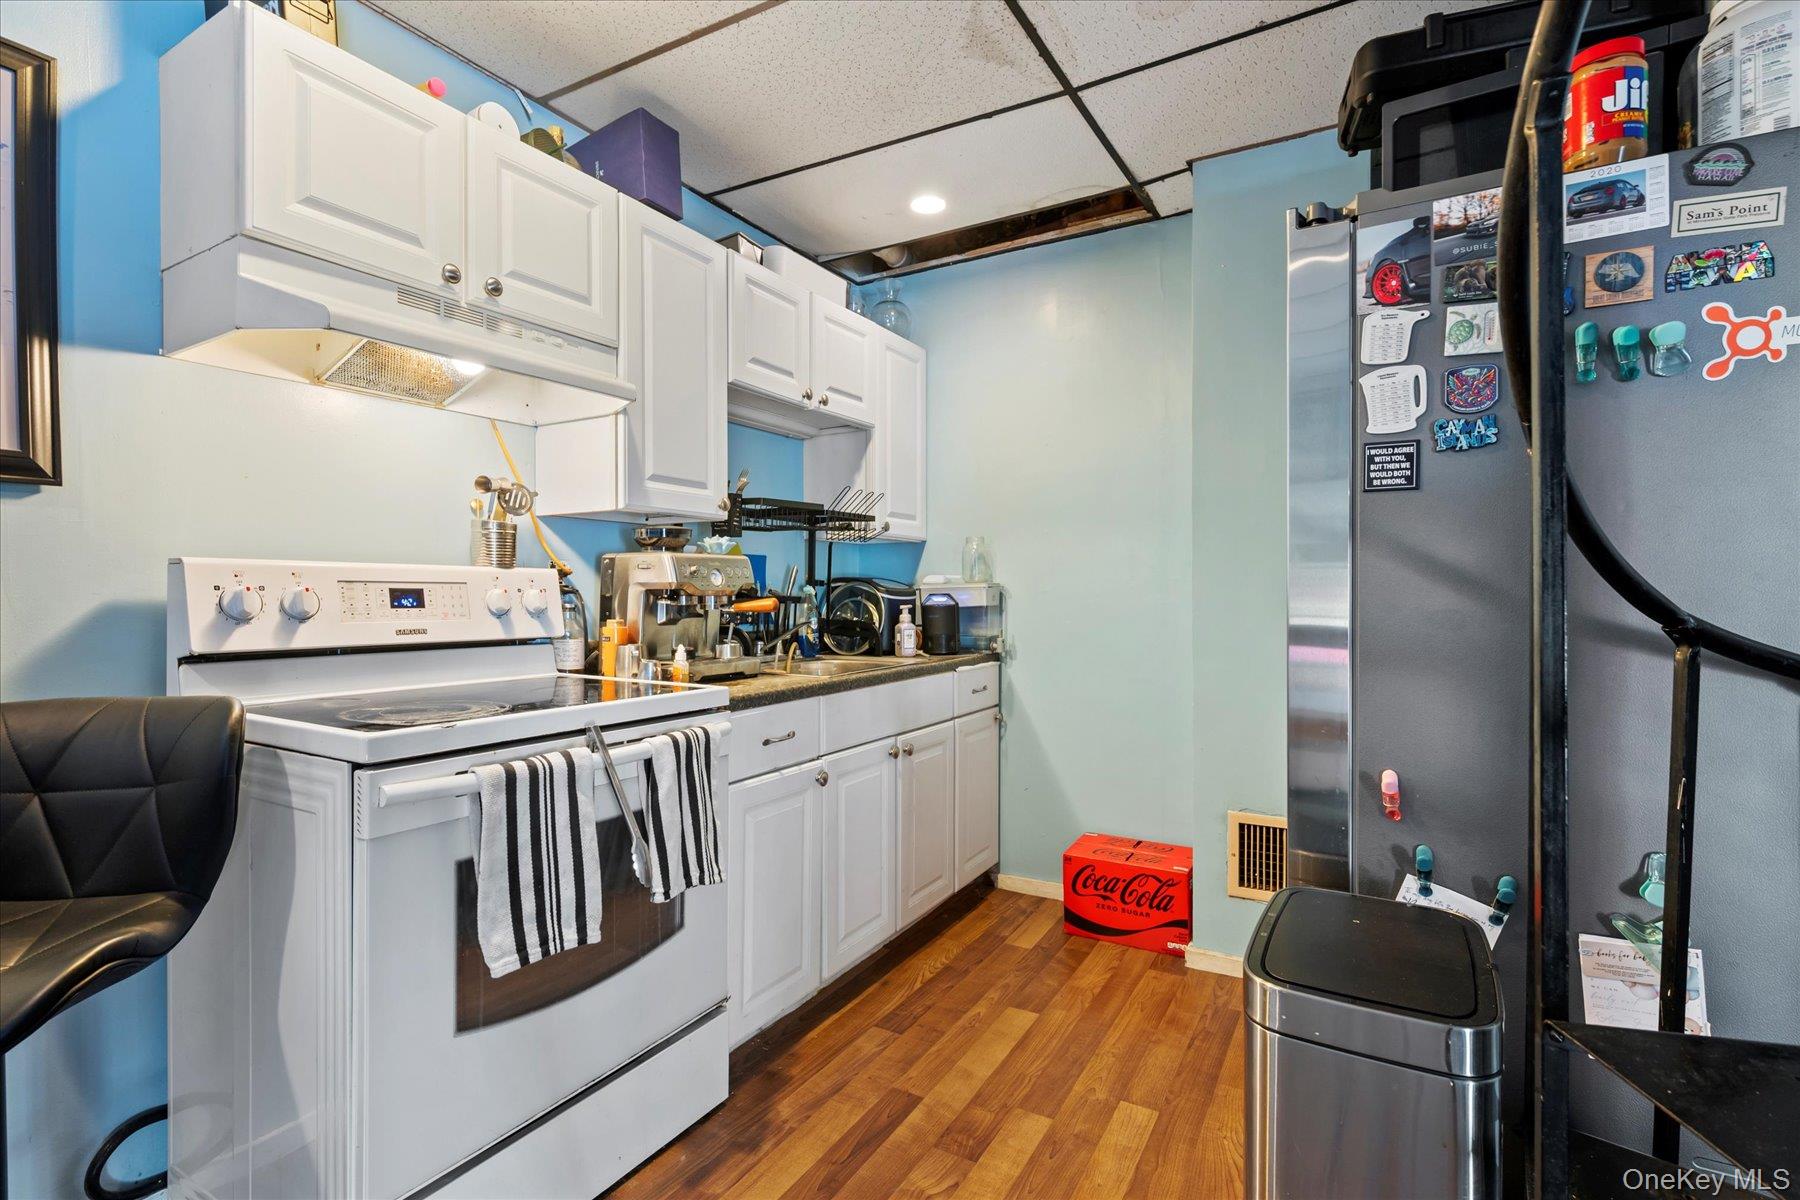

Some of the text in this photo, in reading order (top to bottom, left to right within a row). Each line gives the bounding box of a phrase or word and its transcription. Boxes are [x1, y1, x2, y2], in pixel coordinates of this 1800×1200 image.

[1590, 165, 1622, 178] 2020
[1686, 203, 1768, 221] Sam's Point
[1370, 448, 1393, 456] WOULD
[1393, 446, 1414, 454] AGREE
[395, 628, 428, 636] SAMSUNG
[1071, 864, 1182, 913] Coca-Cola
[1096, 903, 1151, 919] ZERO SUGAR
